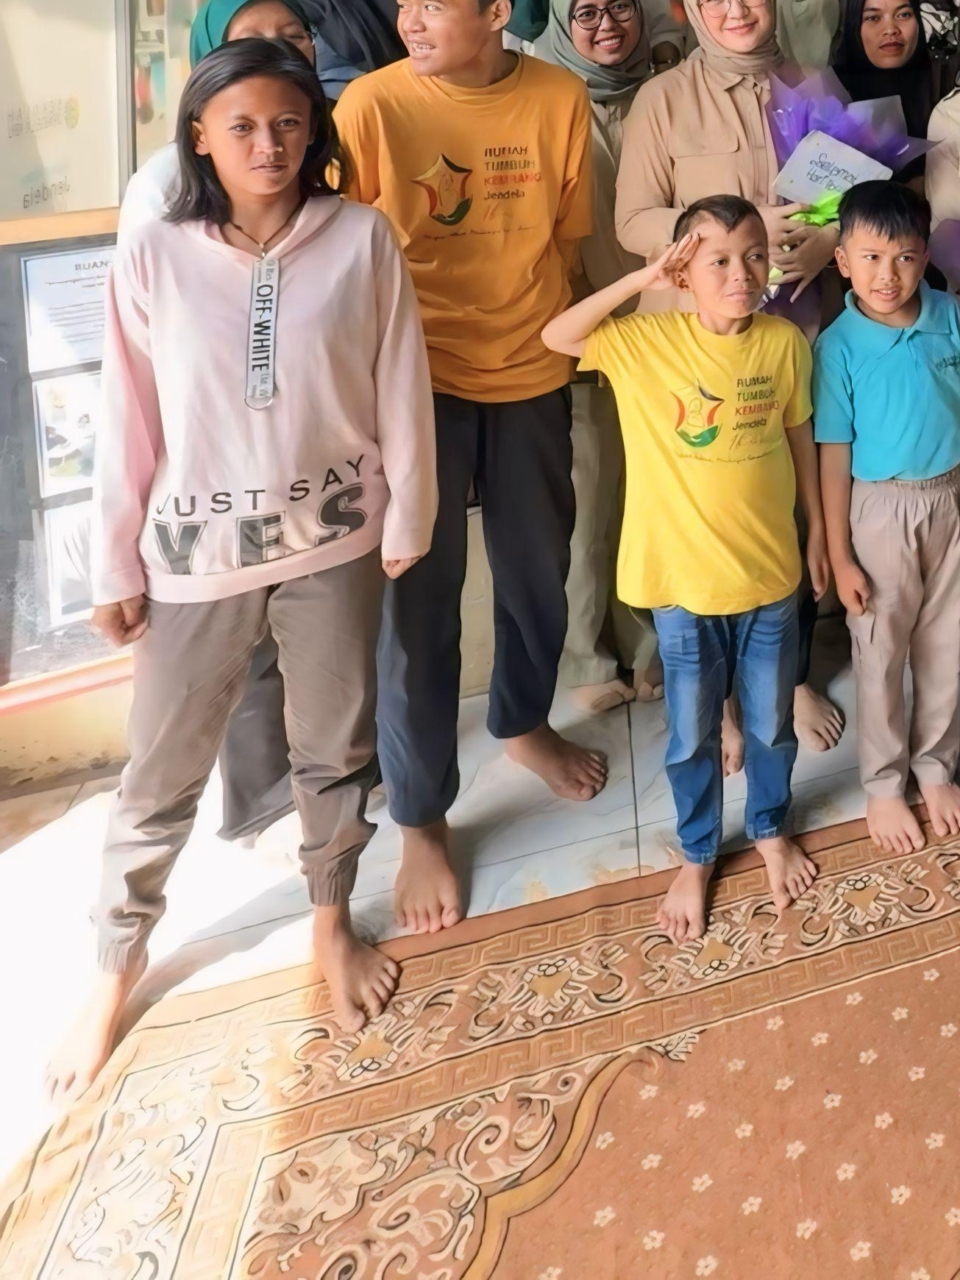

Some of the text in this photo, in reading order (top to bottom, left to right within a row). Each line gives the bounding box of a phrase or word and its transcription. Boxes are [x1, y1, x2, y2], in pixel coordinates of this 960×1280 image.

[156, 454, 365, 517] JUST SAY
[152, 482, 368, 576] YES
